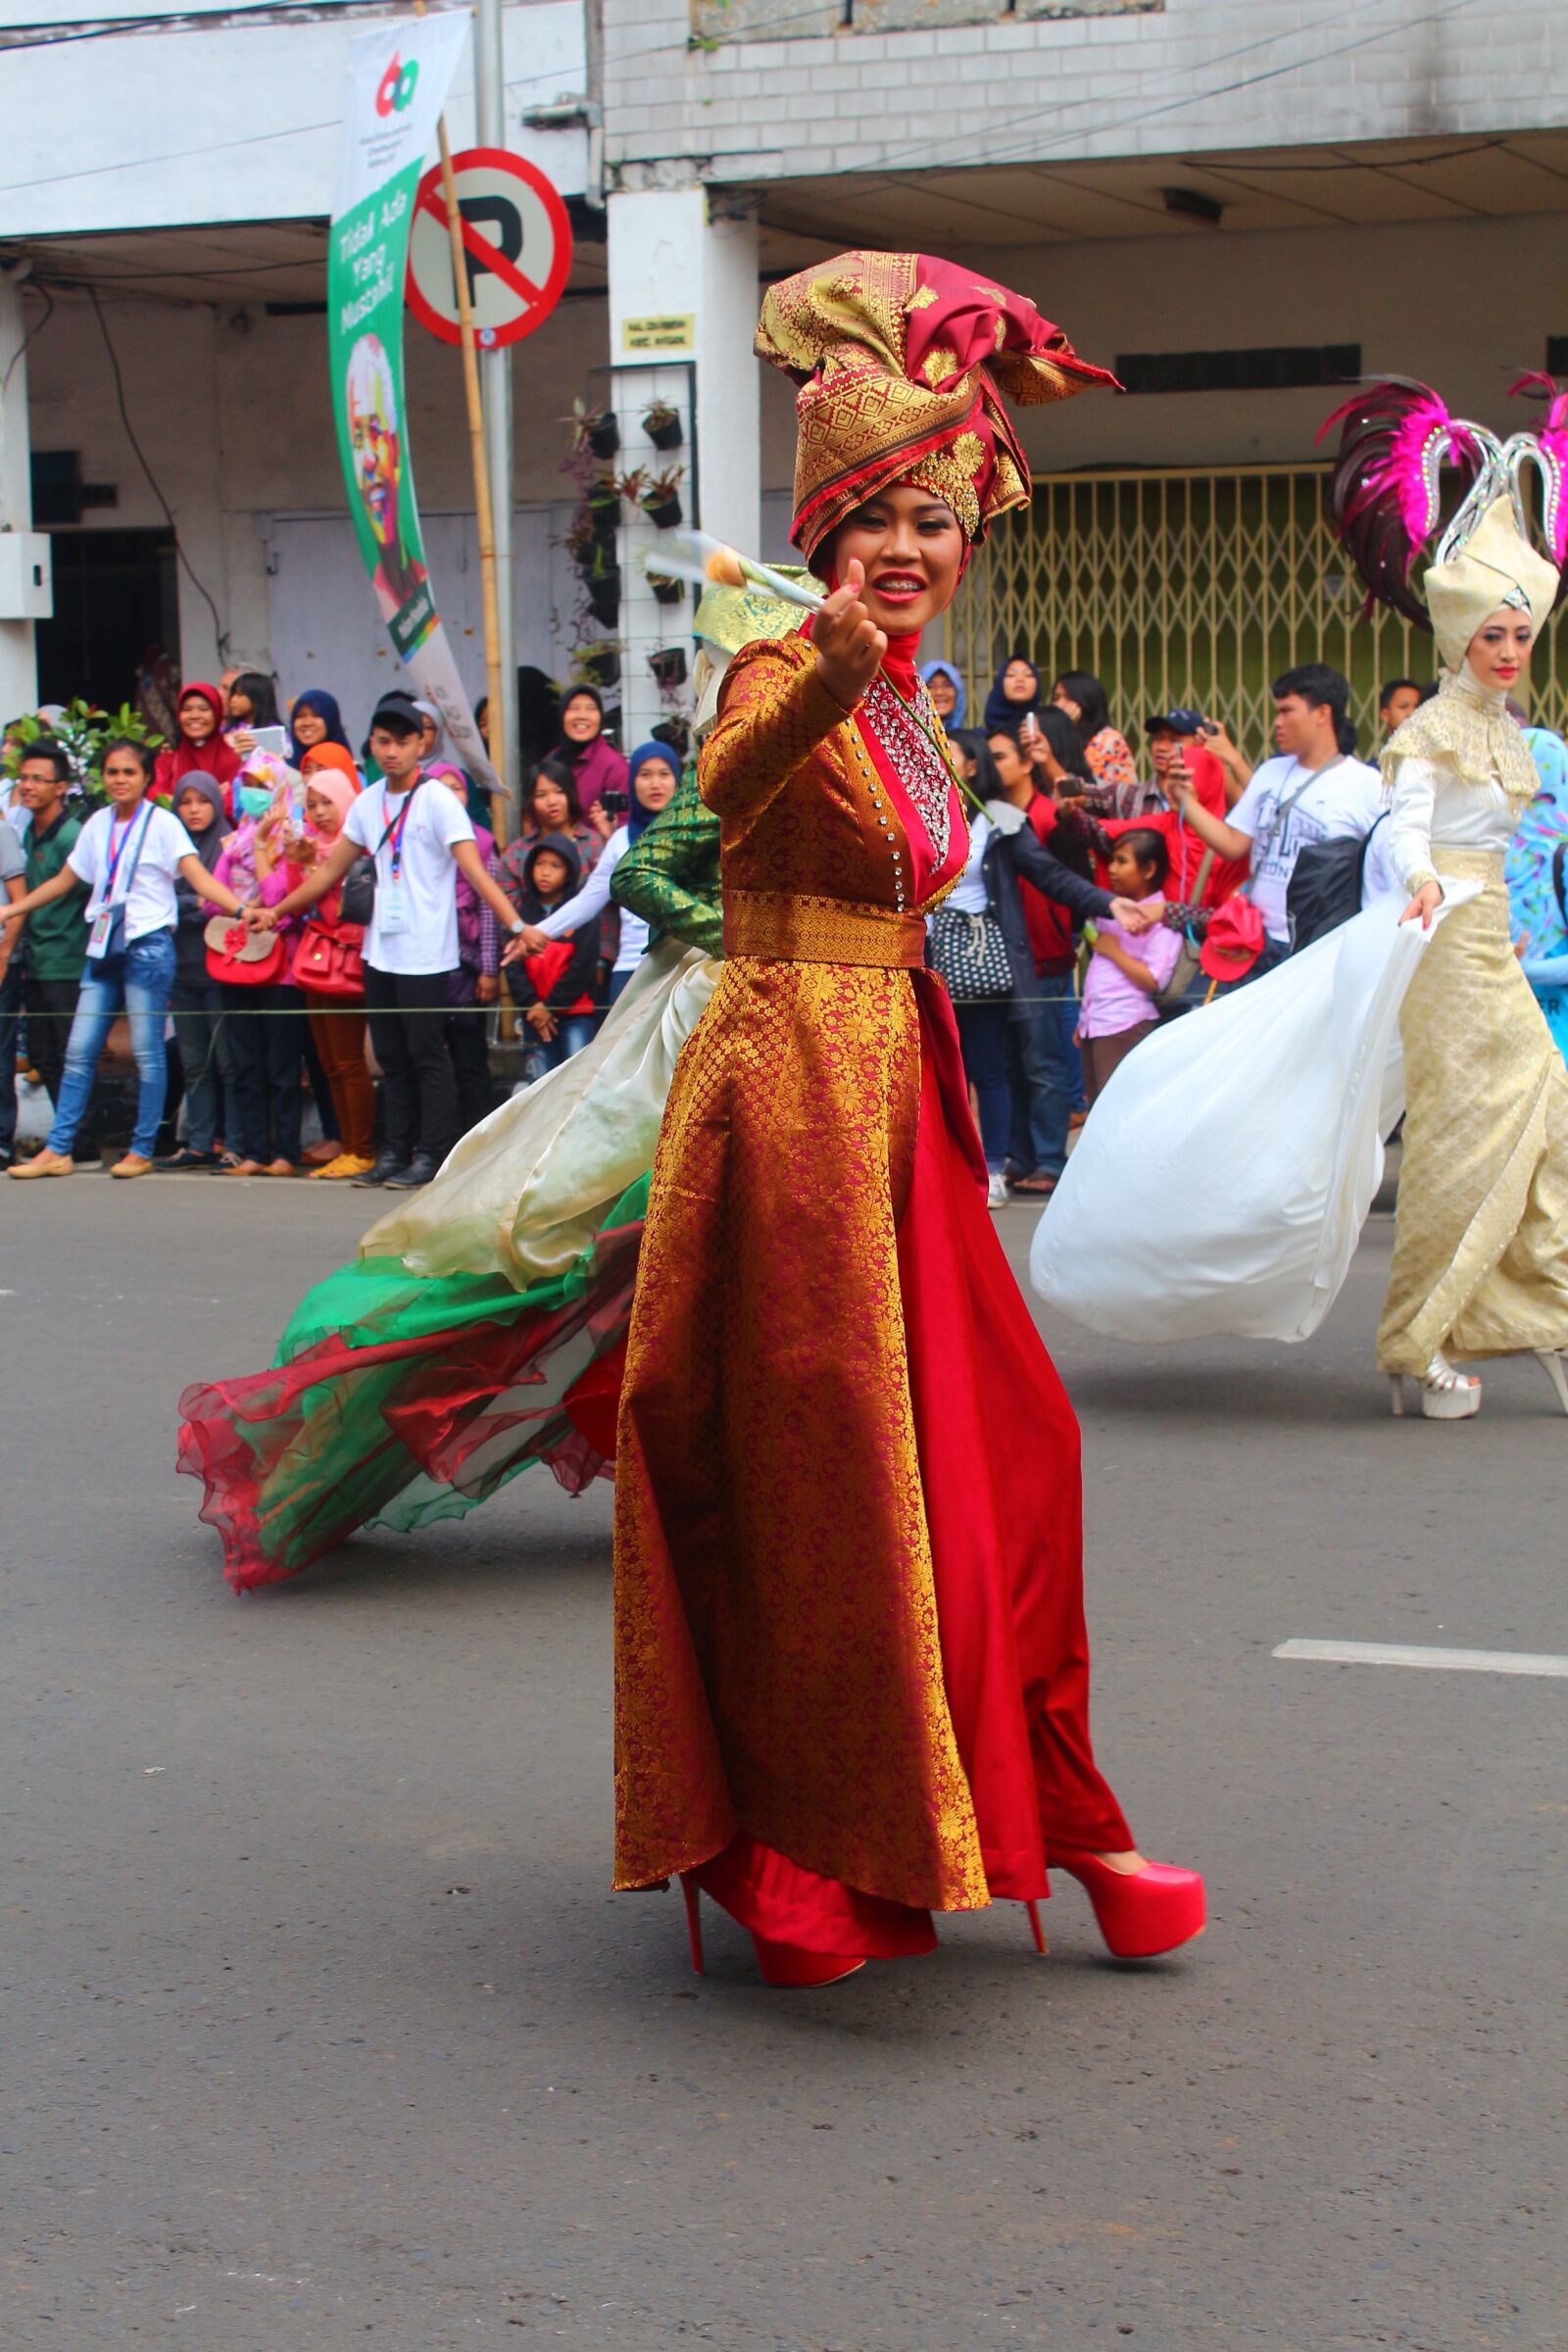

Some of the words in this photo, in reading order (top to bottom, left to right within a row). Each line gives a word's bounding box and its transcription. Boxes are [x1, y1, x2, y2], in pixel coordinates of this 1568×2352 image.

[340, 210, 375, 264] Tidak
[378, 187, 408, 233] Ada
[454, 195, 523, 311] P
[341, 261, 395, 336] Mustahil
[353, 242, 386, 287] Yang
